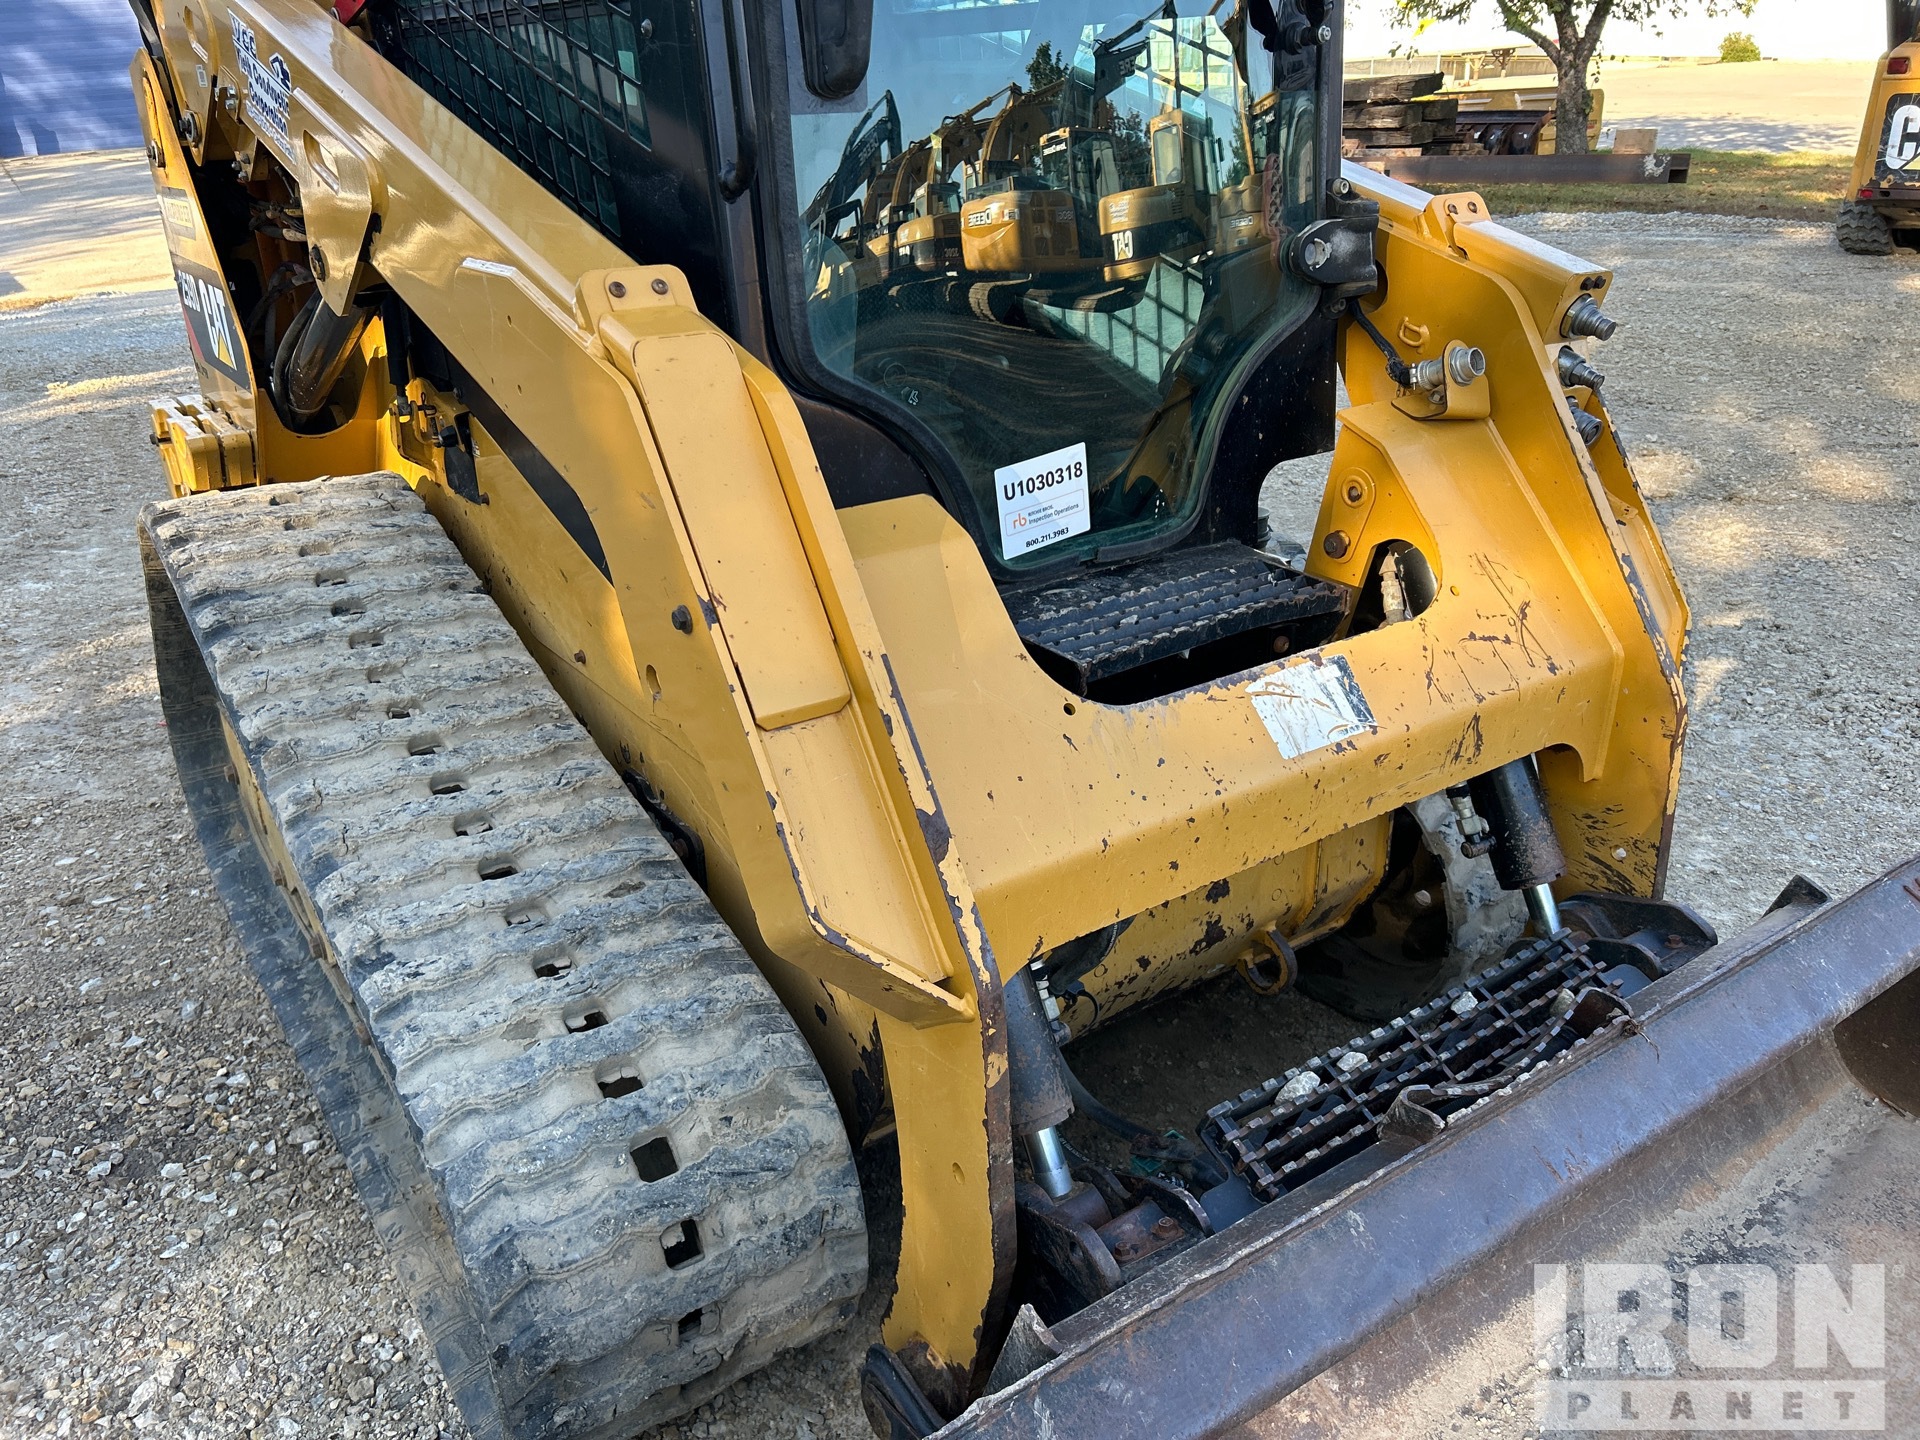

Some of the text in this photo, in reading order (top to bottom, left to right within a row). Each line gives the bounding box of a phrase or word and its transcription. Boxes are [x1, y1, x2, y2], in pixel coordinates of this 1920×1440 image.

[1886, 104, 1920, 170] C
[198, 278, 237, 371] CAT
[1003, 461, 1083, 501] U1030318
[1028, 503, 1079, 525] Inspection Operations
[1025, 526, 1069, 548] 800.211.3983
